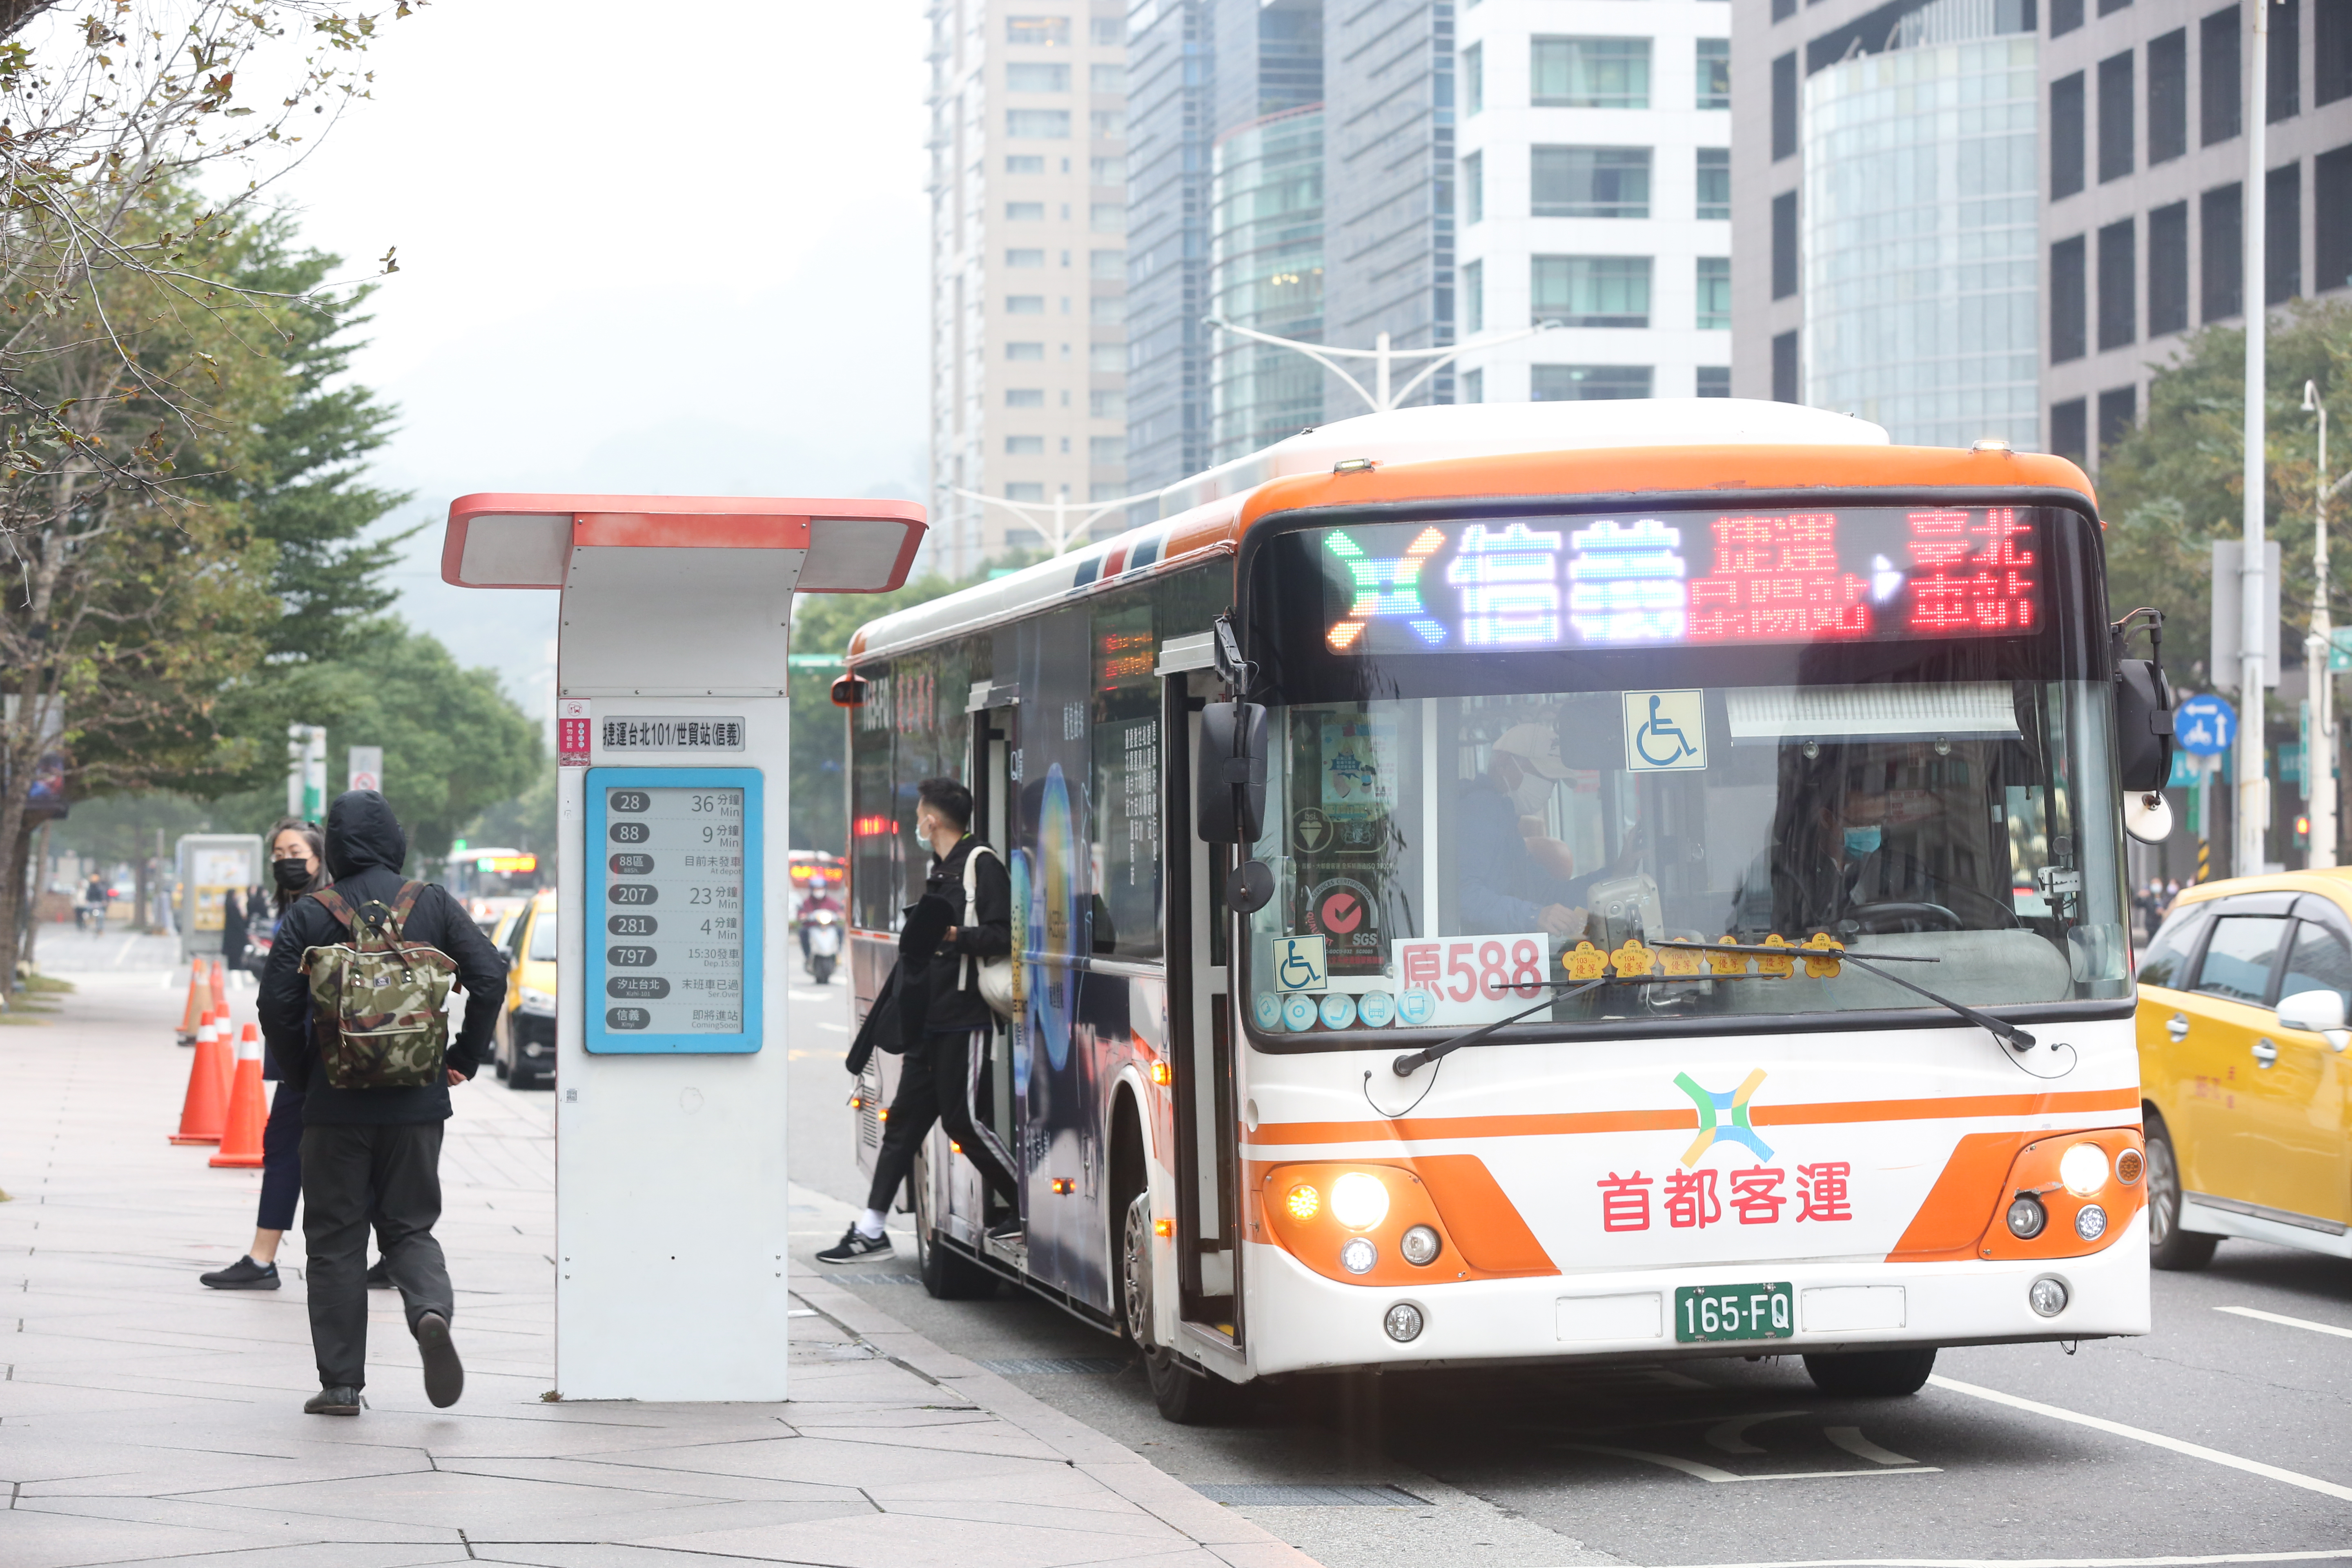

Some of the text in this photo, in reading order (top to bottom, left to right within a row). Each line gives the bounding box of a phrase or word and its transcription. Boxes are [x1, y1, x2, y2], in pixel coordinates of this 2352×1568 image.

[1448, 519, 1684, 644] 信義
[603, 722, 740, 746] 捷運台北101/世貿站(信義)
[621, 795, 639, 809] 28
[692, 794, 740, 812] 36 分鐘
[721, 807, 739, 817] Min
[620, 826, 639, 840] 88
[703, 825, 739, 843] 9 分鐘
[720, 838, 739, 847] Min
[619, 856, 741, 867] 88區 目前未發車
[618, 888, 648, 902] 207
[690, 886, 738, 904] 23 分鐘
[1312, 879, 1372, 900] SERVICES CERTIFICATION
[719, 900, 737, 909] Min
[618, 918, 647, 933] 281
[700, 917, 737, 935] 4 分鐘
[718, 930, 737, 940] Min
[1352, 933, 1377, 946] SGS
[618, 948, 739, 964] 797 15:30發車
[1766, 956, 1786, 967] 優等
[1576, 964, 1596, 974] 優等
[1624, 962, 1644, 972] 優等
[1671, 960, 1691, 970] 優等
[1718, 958, 1739, 969] 優等
[617, 979, 739, 990] 汐止台北 末班車已過
[617, 1009, 738, 1021] 信義 即將進站
[692, 1021, 738, 1029] ComingSoon
[1597, 1161, 1853, 1232] 首都客運
[1684, 1293, 1790, 1335] 165-FQ
